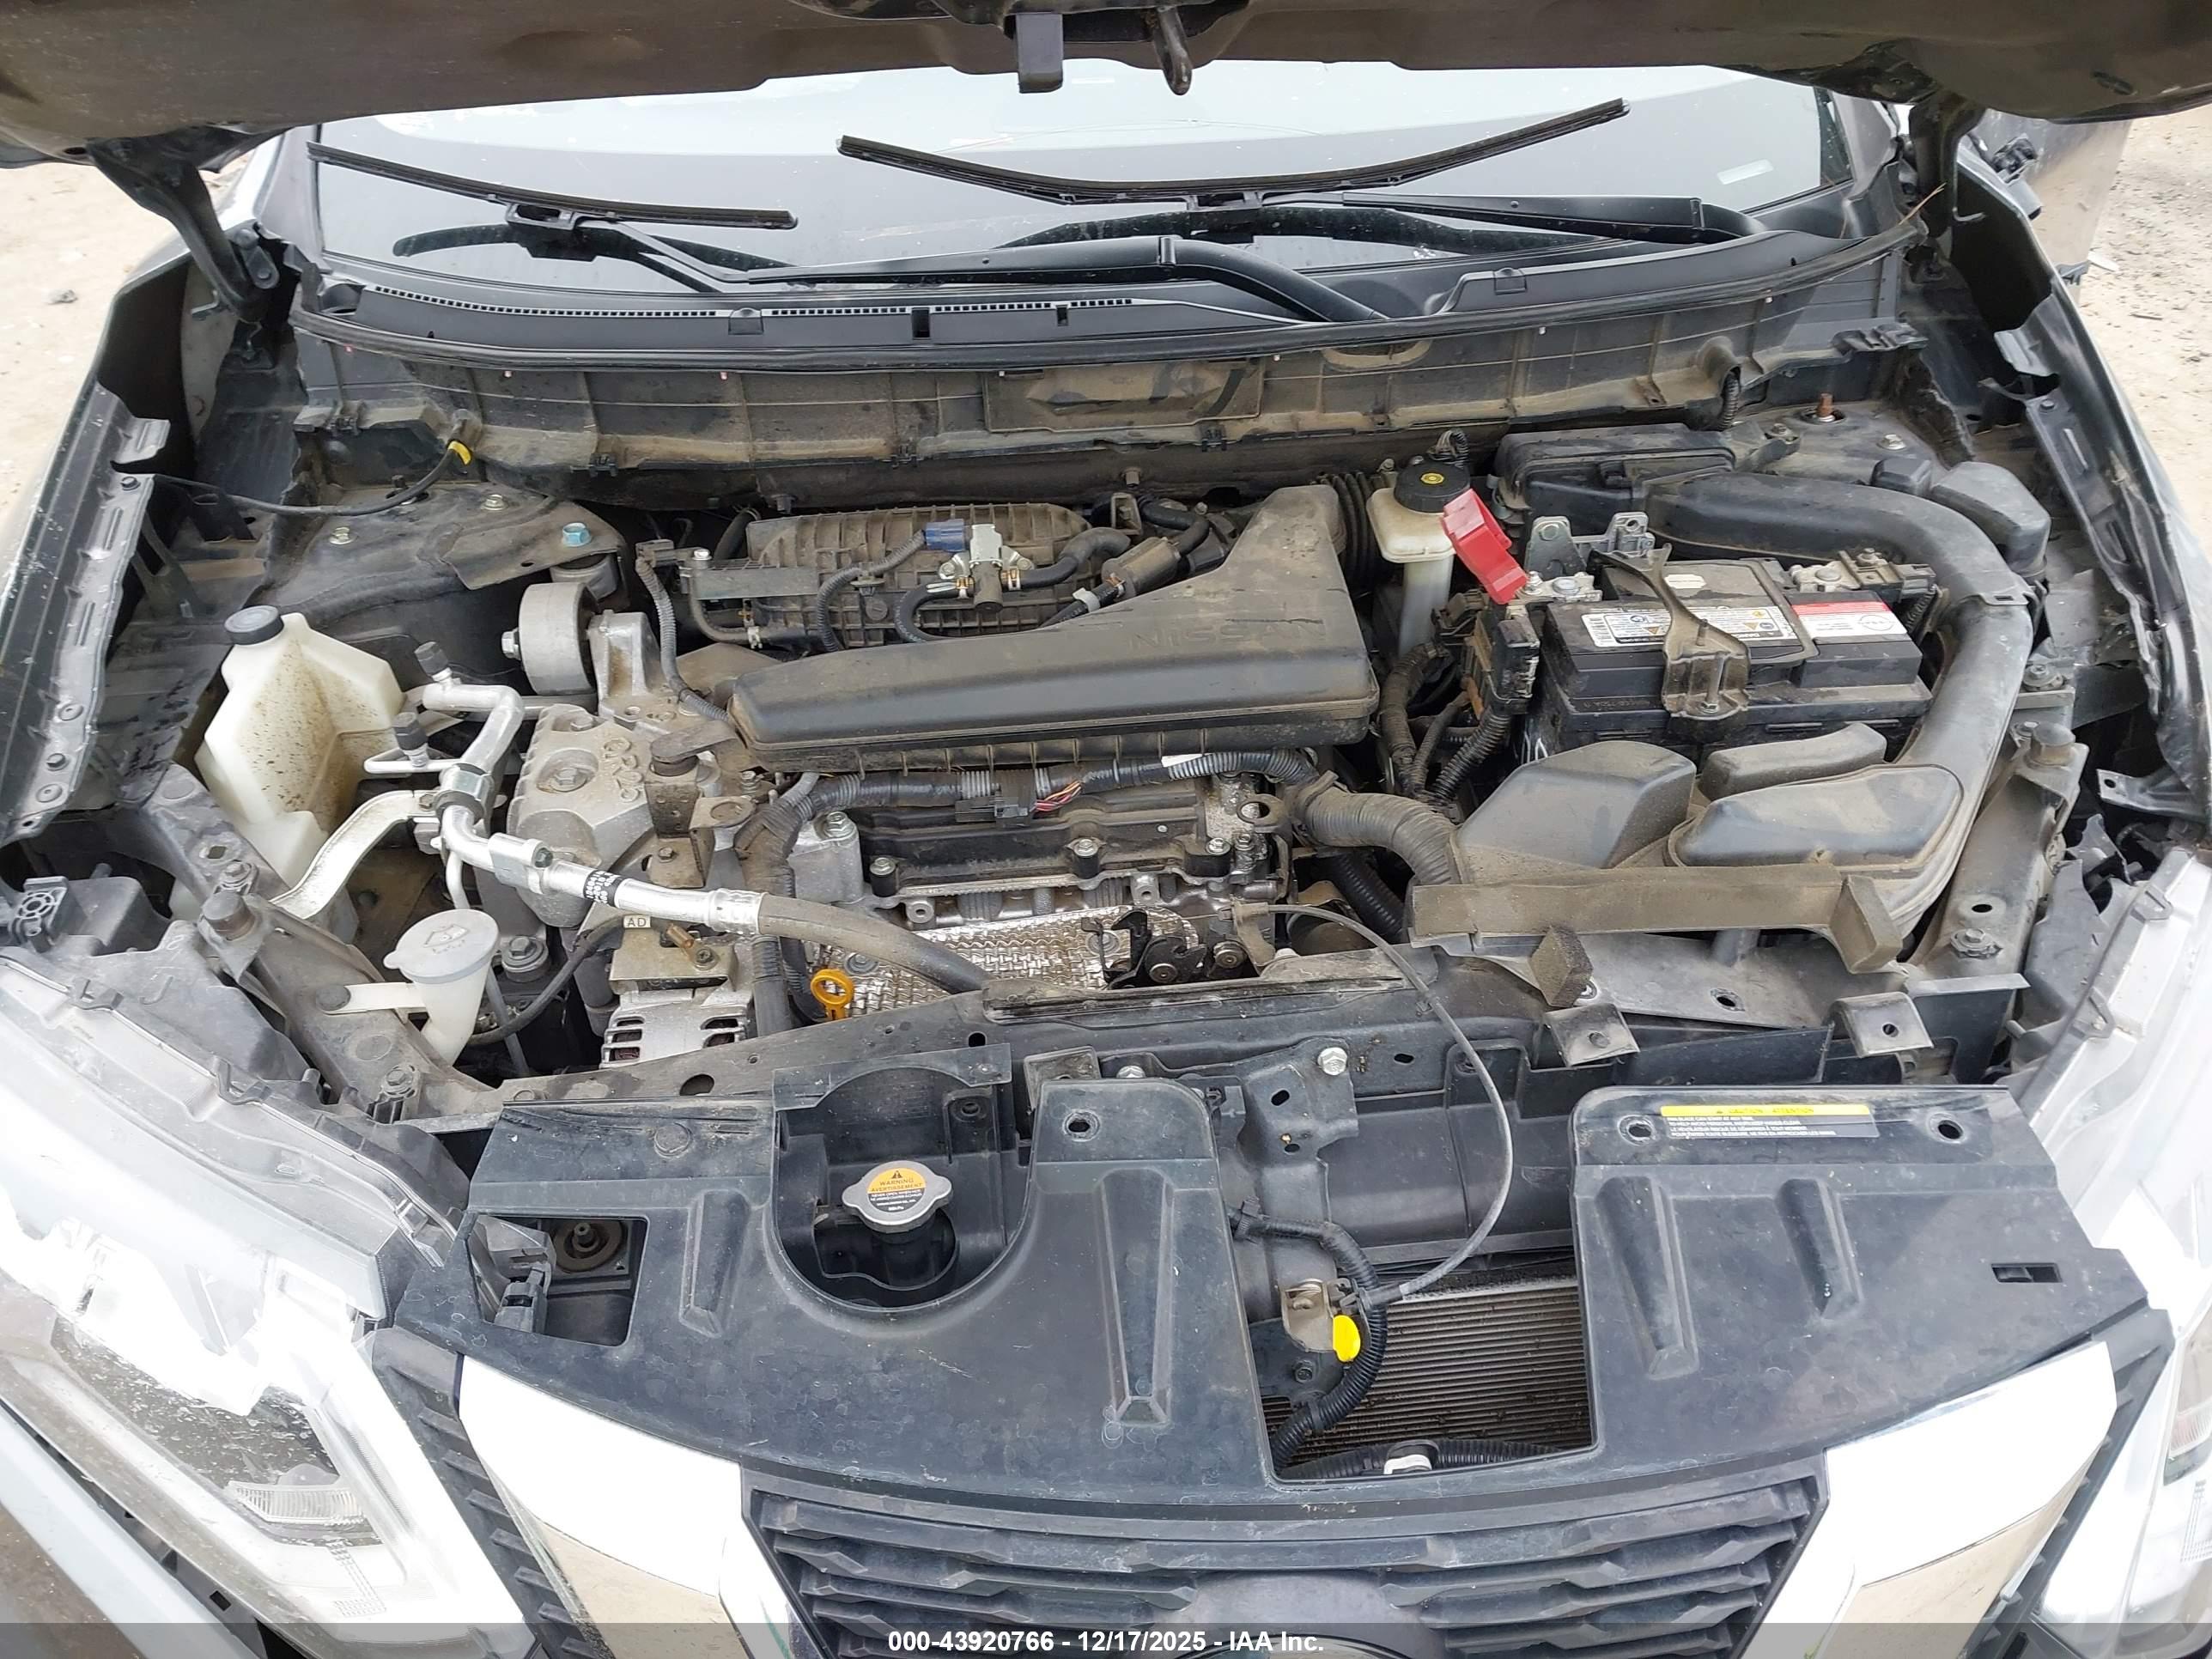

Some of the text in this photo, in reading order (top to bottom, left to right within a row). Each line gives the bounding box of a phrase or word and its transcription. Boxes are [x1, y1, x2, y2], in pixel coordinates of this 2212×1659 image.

[1129, 622, 1328, 652] NISSAN
[627, 917, 647, 927] AD
[878, 1177, 915, 1186] WARNING
